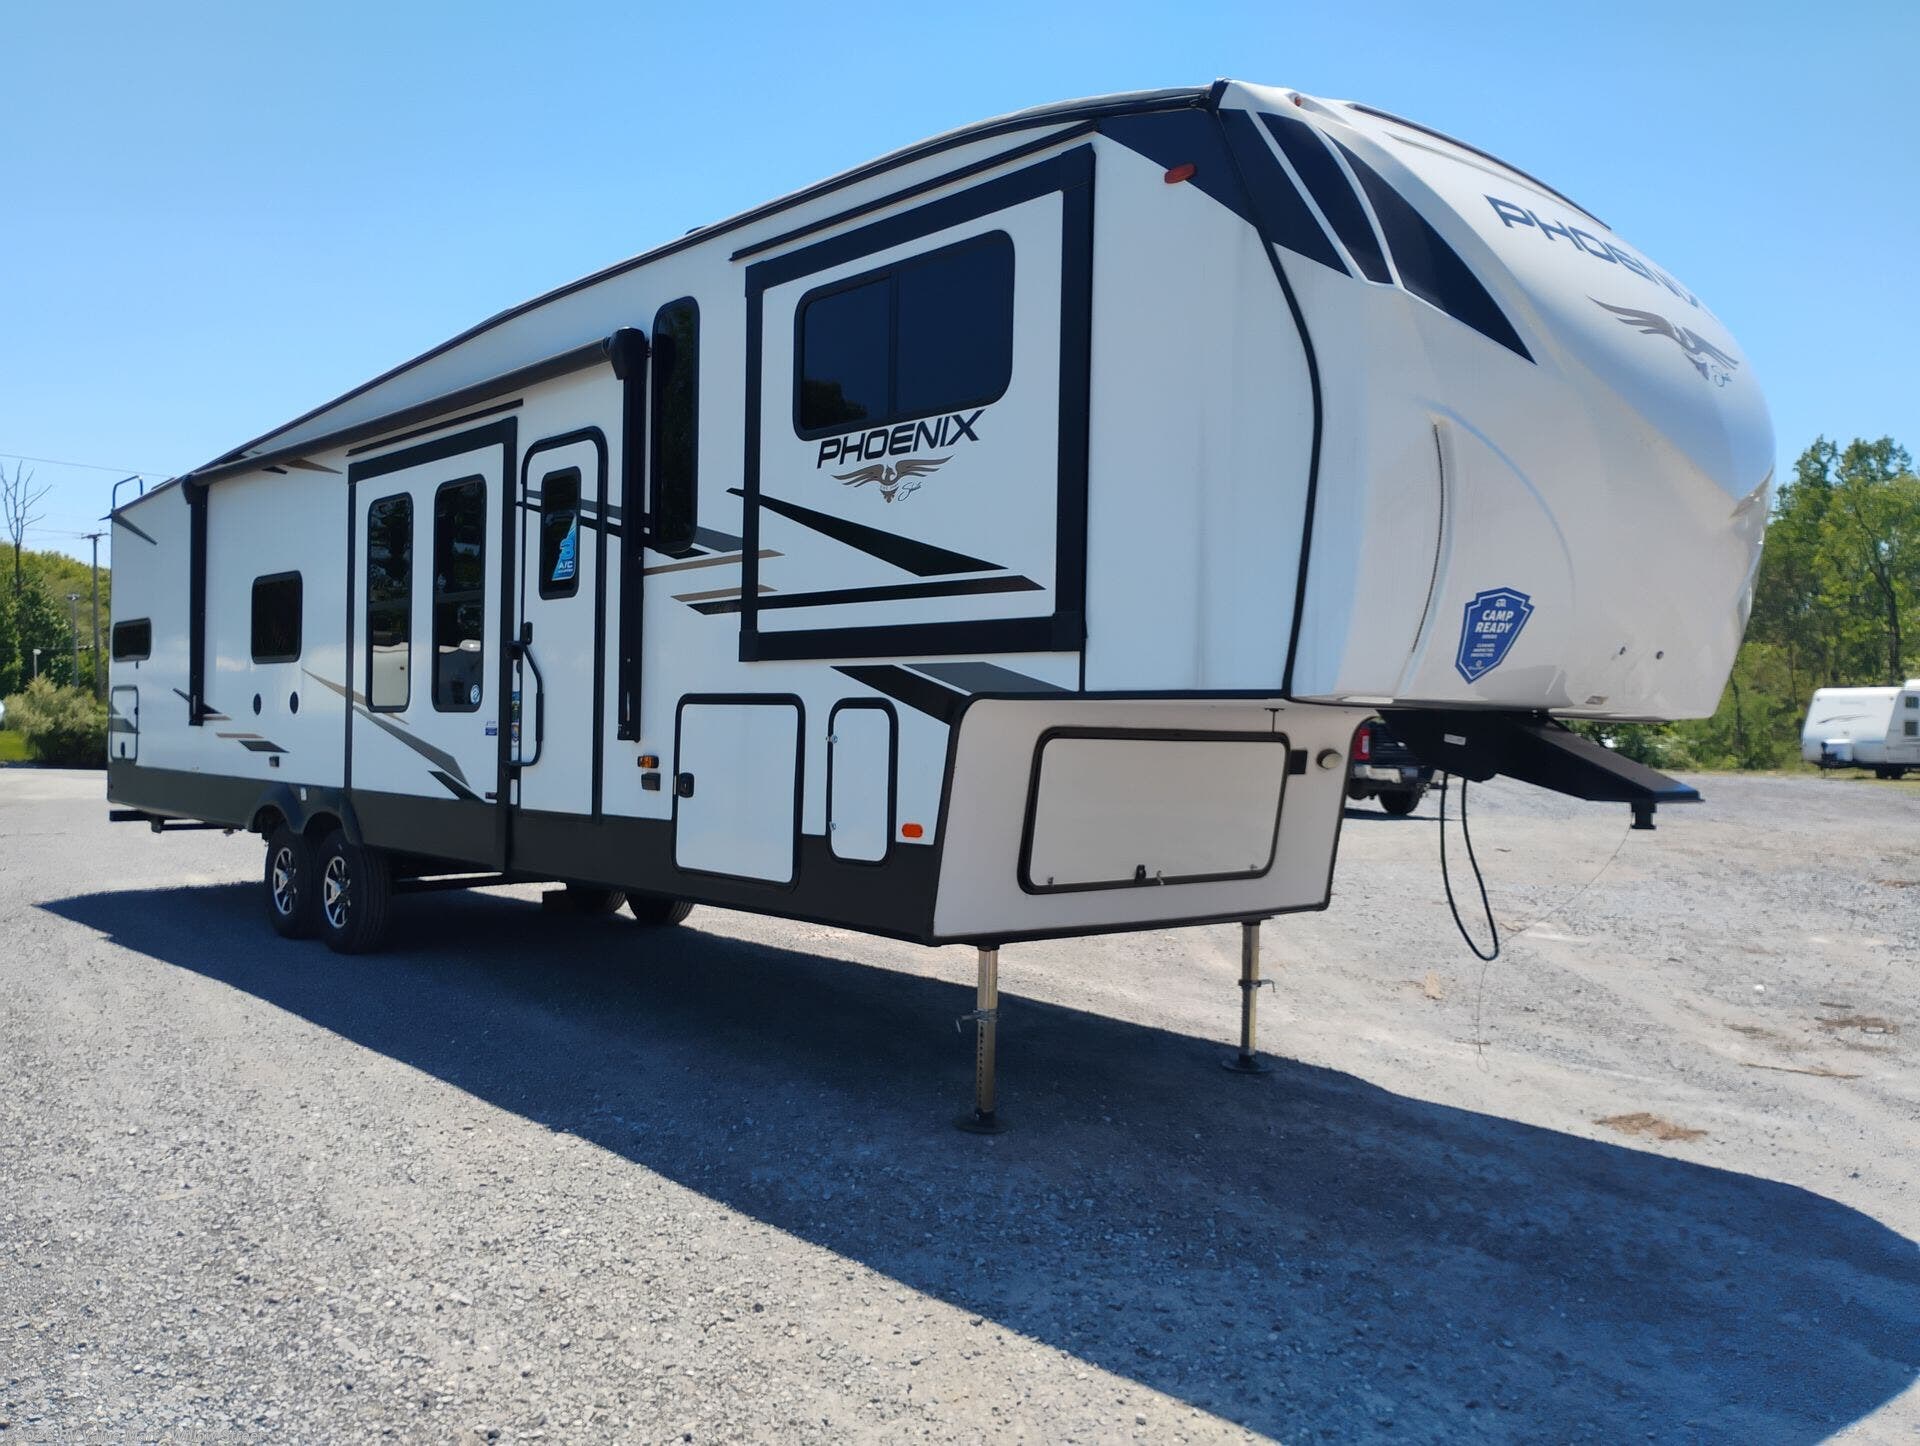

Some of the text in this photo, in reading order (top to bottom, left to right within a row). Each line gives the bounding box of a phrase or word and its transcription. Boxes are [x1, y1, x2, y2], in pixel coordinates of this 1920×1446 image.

[1482, 193, 1698, 308] PHOEN
[817, 409, 985, 469] PHOENIX
[1475, 622, 1512, 633] READY
[1483, 610, 1514, 621] CAMP
